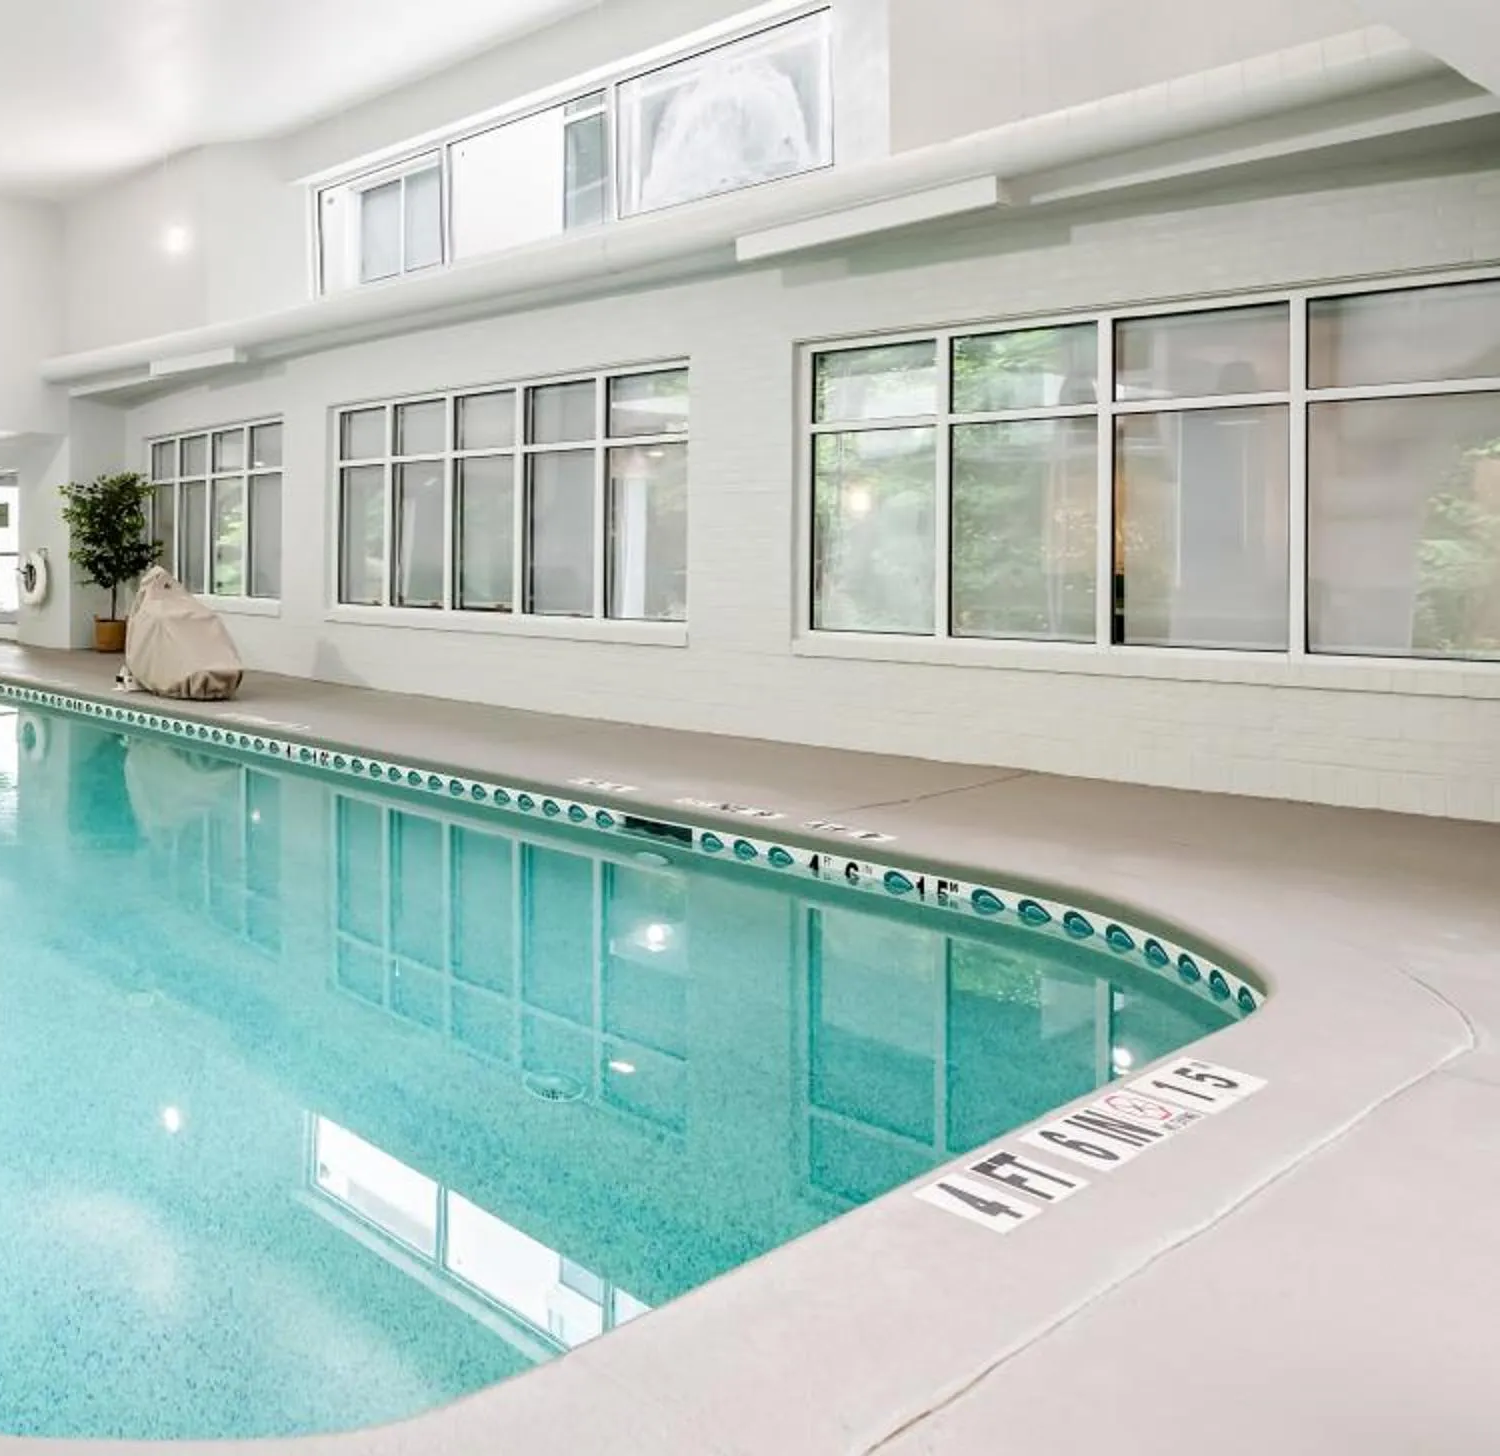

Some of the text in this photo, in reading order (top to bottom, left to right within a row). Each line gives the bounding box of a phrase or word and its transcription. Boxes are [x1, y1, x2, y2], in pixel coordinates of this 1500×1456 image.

[1037, 1129, 1121, 1161] 6
[1063, 1108, 1165, 1147] IN
[969, 1151, 1077, 1201] FT
[936, 1182, 1023, 1219] 4
